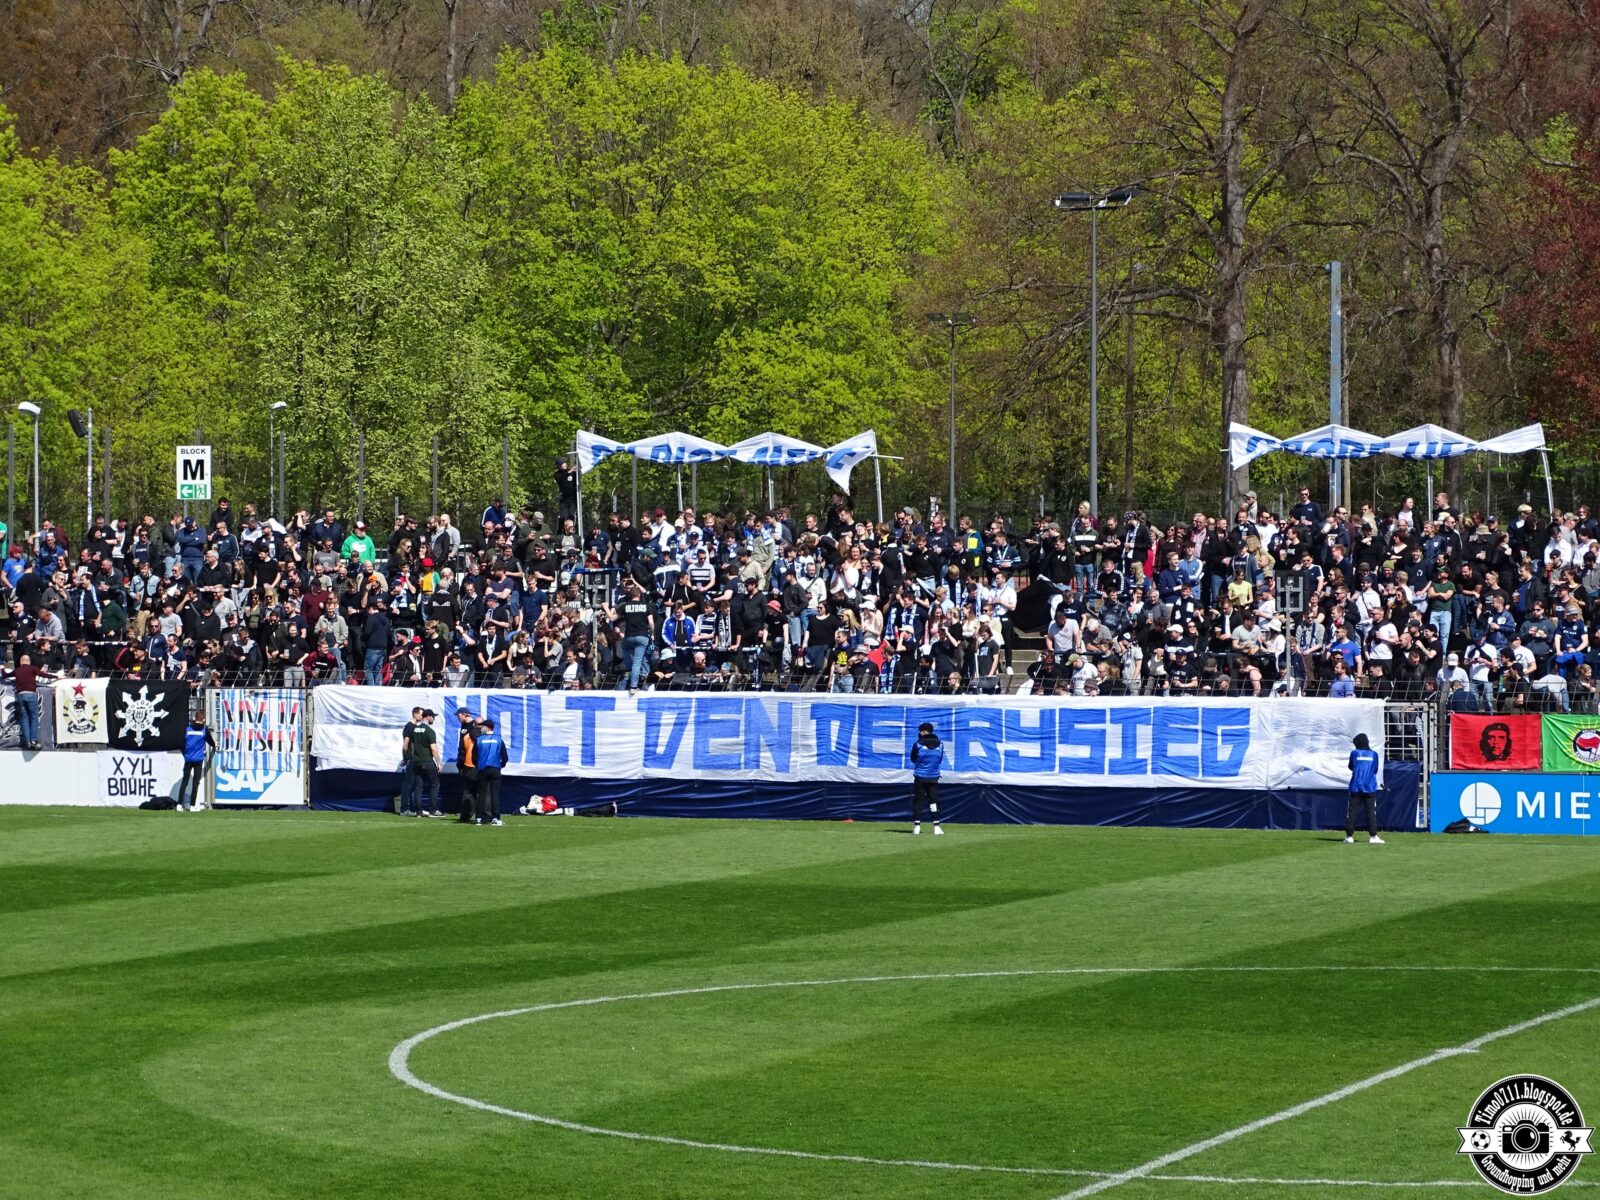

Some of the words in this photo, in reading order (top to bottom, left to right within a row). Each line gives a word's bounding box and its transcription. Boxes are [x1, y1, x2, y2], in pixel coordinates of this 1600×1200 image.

[183, 459, 205, 480] M
[443, 694, 616, 767] HOLT
[637, 696, 793, 773] DEN
[810, 703, 1251, 778] DERBYSIEG
[216, 768, 277, 792] SAP
[1516, 791, 1600, 820] MIE
